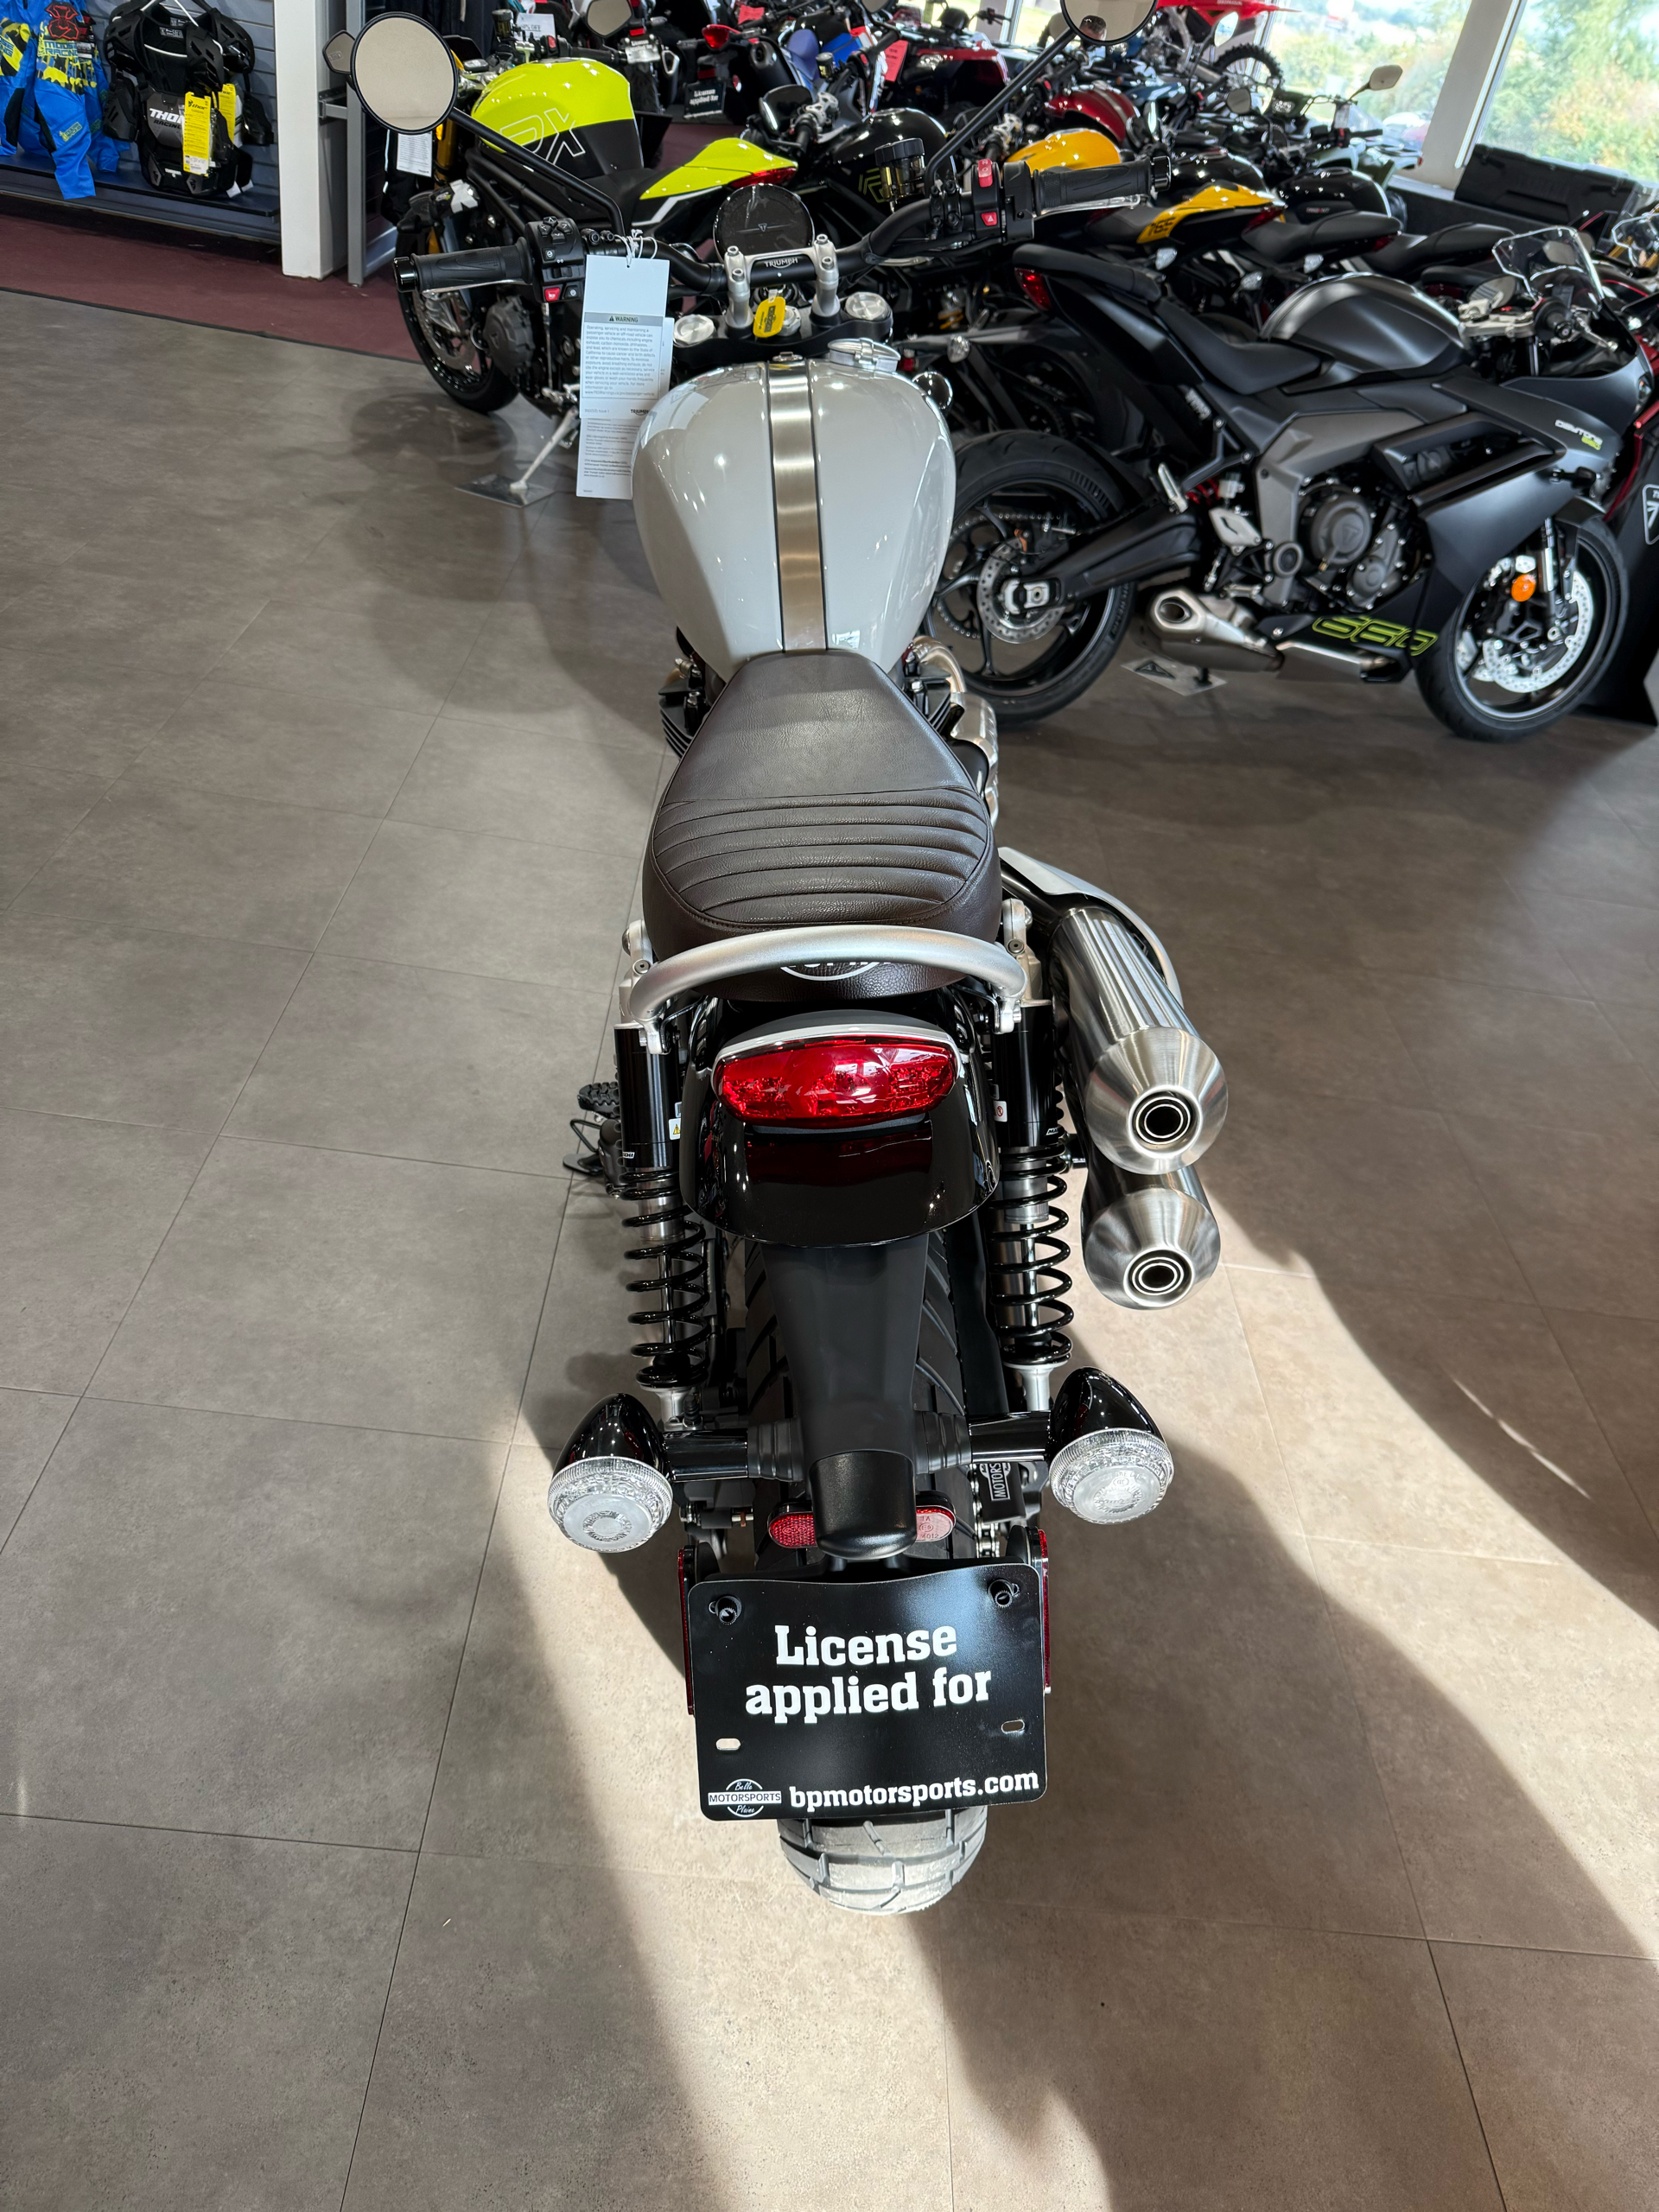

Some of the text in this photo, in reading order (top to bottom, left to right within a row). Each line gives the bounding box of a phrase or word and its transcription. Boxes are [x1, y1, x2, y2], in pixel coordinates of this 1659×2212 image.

[764, 257, 798, 268] TRIUMPH
[775, 1624, 957, 1666] License
[746, 1667, 992, 1724] applied for
[709, 1793, 781, 1802] MOTORSPORTS
[734, 1782, 753, 1791] Belle
[790, 1770, 1039, 1812] bpmotorsports.com
